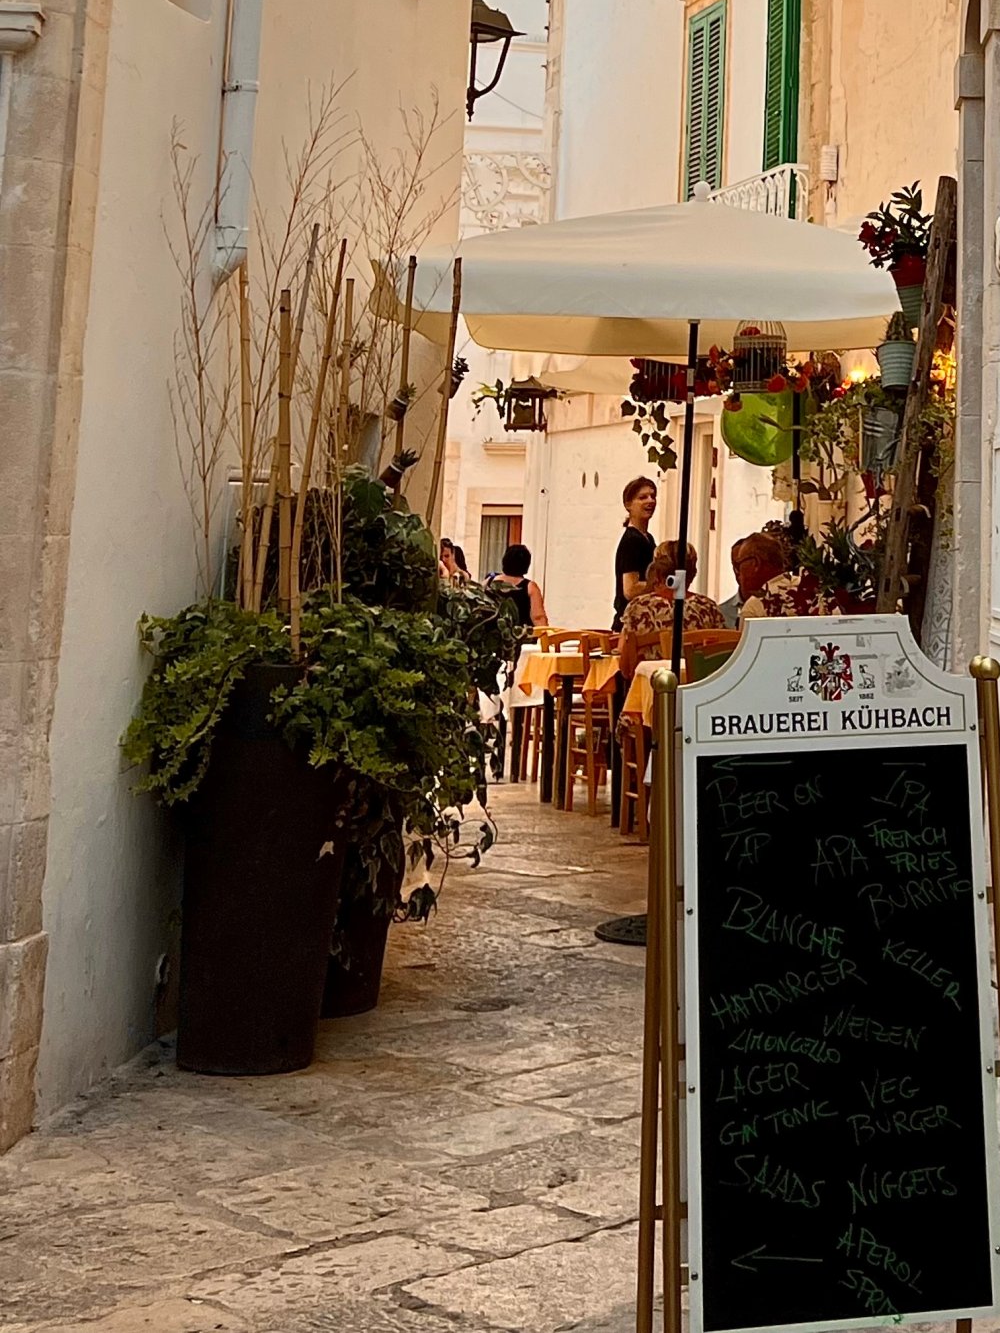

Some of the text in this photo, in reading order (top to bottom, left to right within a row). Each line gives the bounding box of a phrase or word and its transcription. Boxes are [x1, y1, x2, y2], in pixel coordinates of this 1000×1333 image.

[711, 704, 951, 736] BRAUEREI KÜHBACH
[788, 695, 804, 703] SEIT
[705, 775, 789, 829] BEER
[871, 770, 931, 826] IPA
[864, 819, 947, 847] FRENCH
[810, 835, 869, 886] APA
[885, 851, 957, 873] FRIES
[722, 886, 845, 959] BLANCHE
[710, 958, 868, 1029] HAMBURGER
[882, 939, 961, 1012] KELLER
[728, 1029, 841, 1064] LIMONCELLO
[716, 1062, 810, 1103] LAGER
[861, 1069, 921, 1109] VEG
[764, 1100, 839, 1134] TONIC
[847, 1105, 962, 1146] BURGER
[719, 1154, 826, 1209] SALADS
[848, 1164, 957, 1214] NUGGETS
[836, 1223, 923, 1295] APEROL
